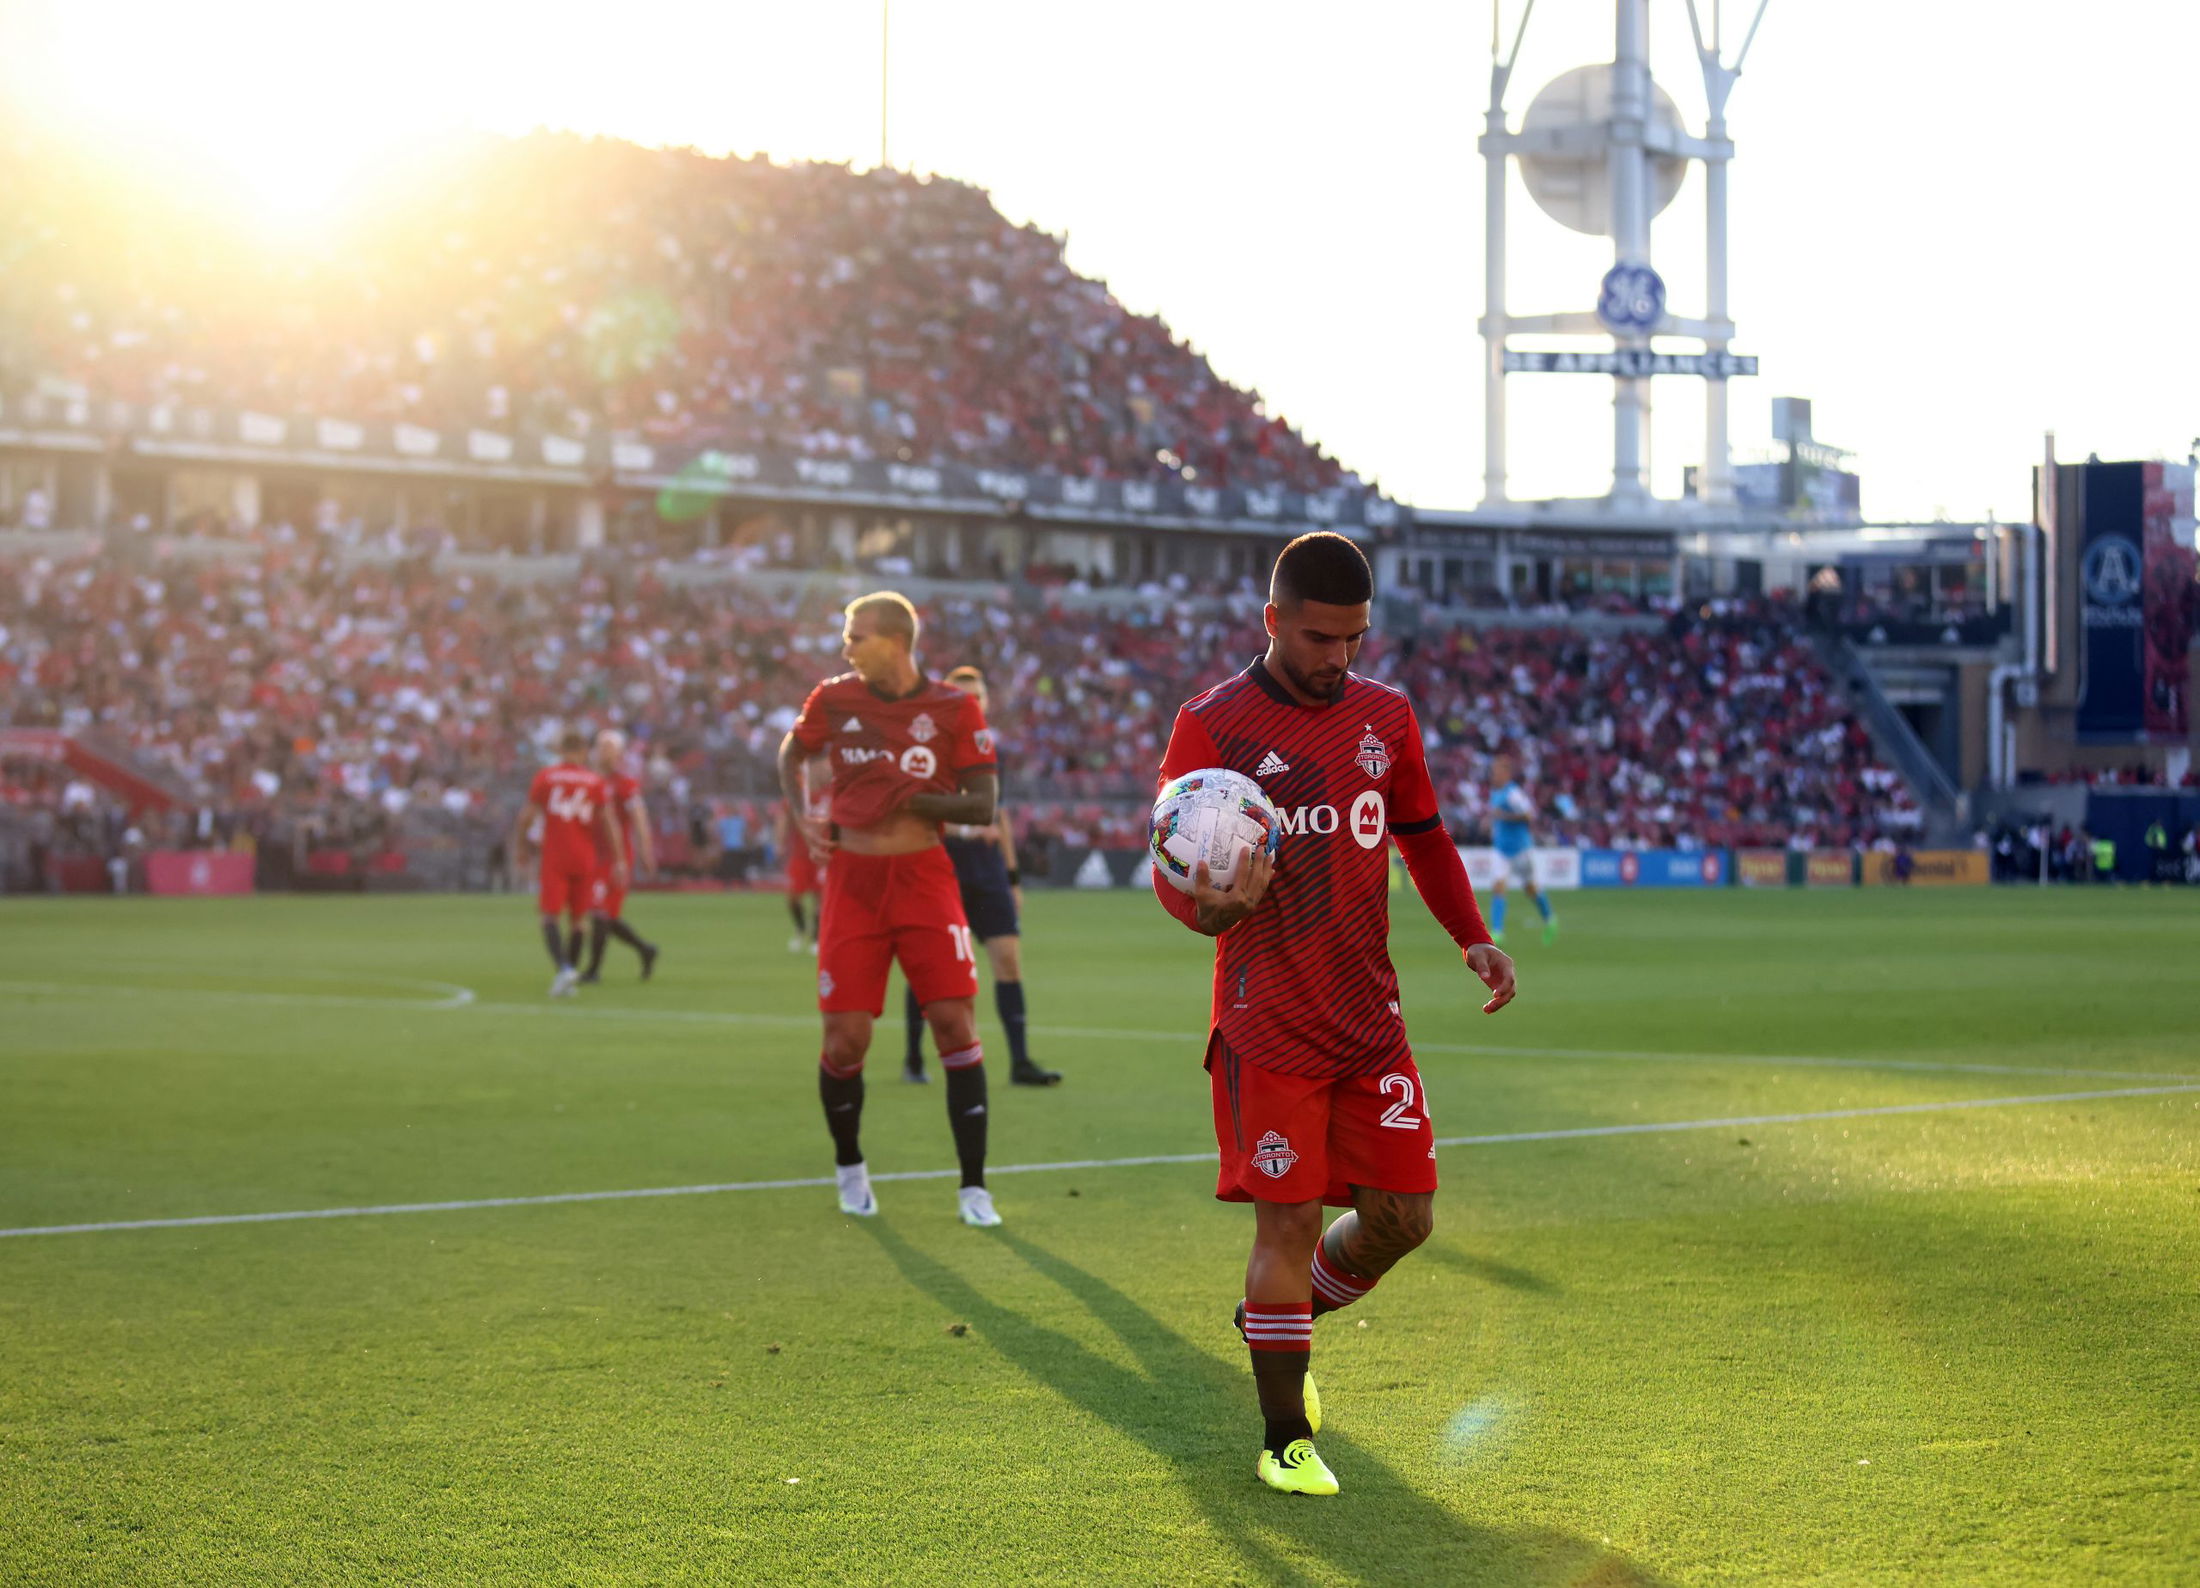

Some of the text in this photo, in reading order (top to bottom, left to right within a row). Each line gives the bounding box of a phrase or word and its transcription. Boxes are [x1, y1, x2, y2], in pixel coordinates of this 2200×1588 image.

[1256, 763, 1290, 777] adidas
[548, 784, 592, 825] 44
[1274, 805, 1339, 836] MO
[1379, 1072, 1430, 1130] 2
[1258, 1151, 1291, 1161] TORONTO
